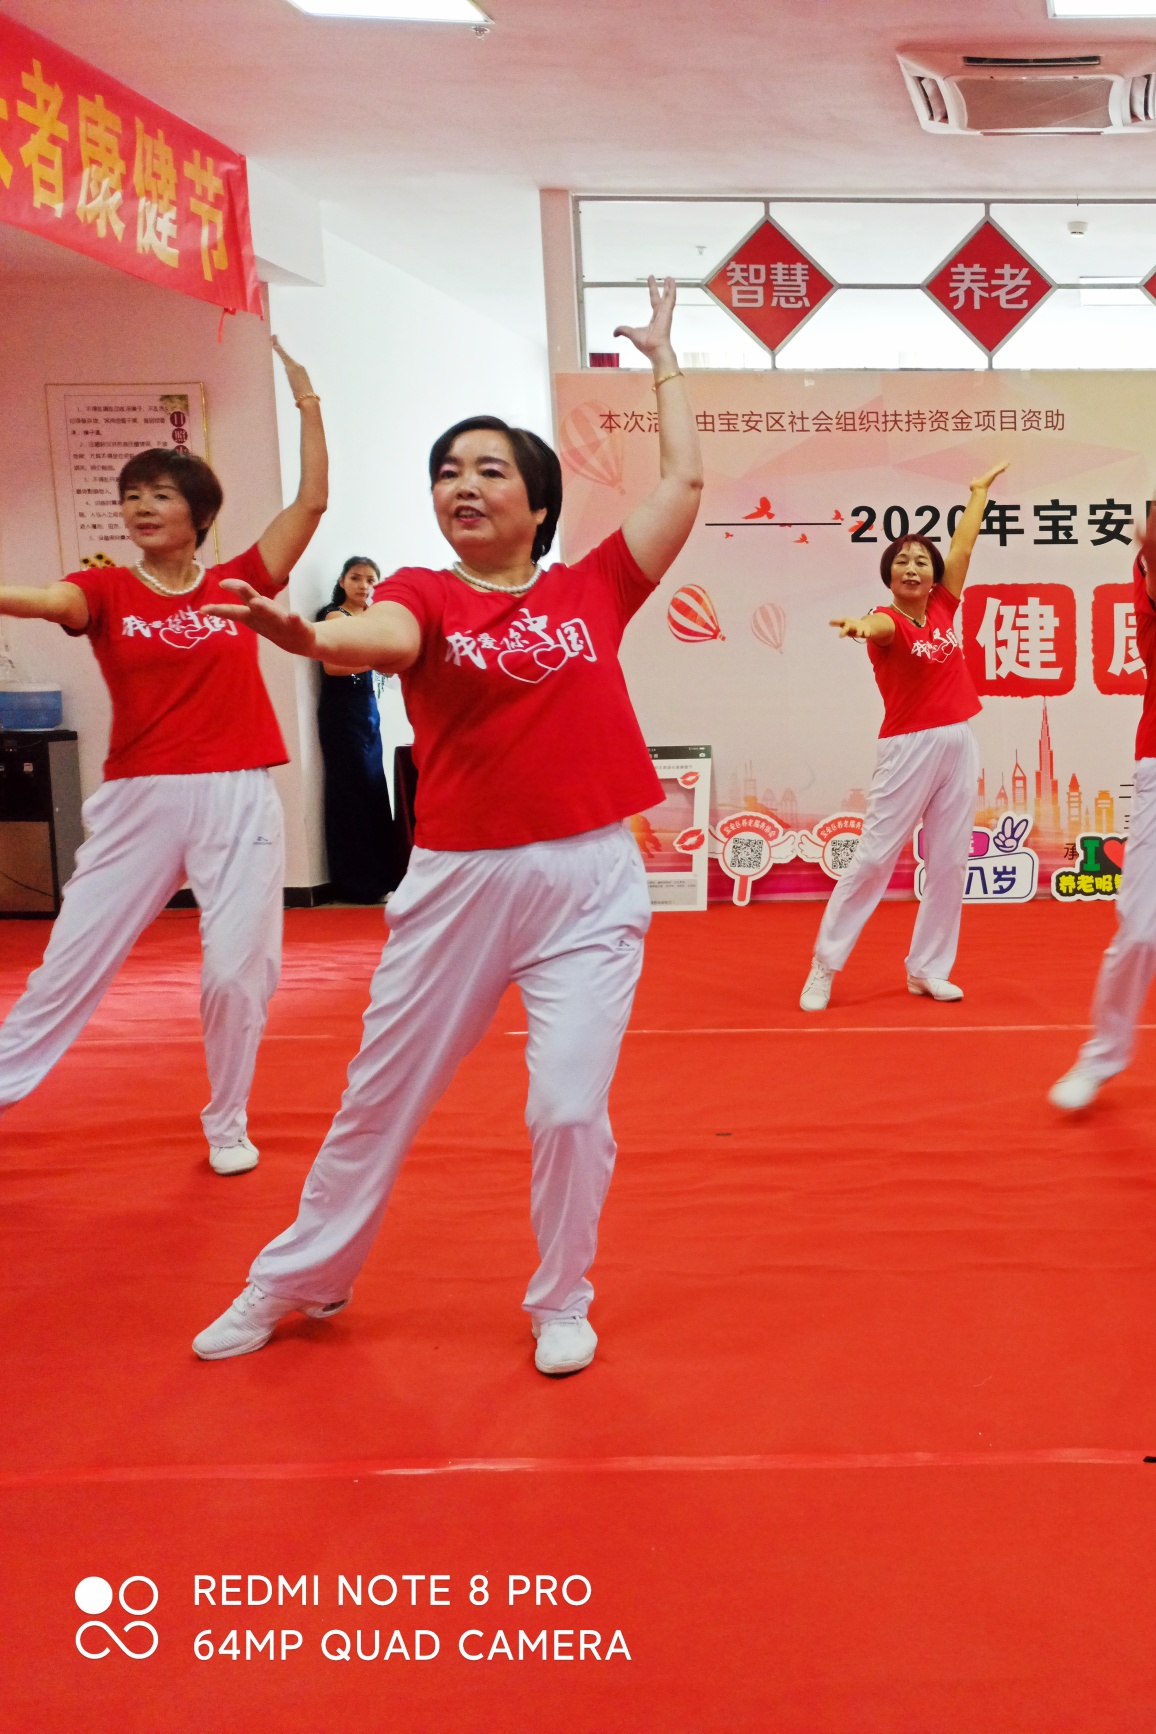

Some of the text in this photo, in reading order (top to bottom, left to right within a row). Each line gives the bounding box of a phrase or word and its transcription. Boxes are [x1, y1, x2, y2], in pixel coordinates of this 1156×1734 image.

[725, 261, 811, 310] 智慧
[948, 262, 1032, 310] 养老
[599, 408, 1065, 434] 本次活由宝安区社会组织扶持资金项目资助
[445, 607, 598, 670] 我爱你中国
[820, 820, 864, 839] 宝安区养老服务
